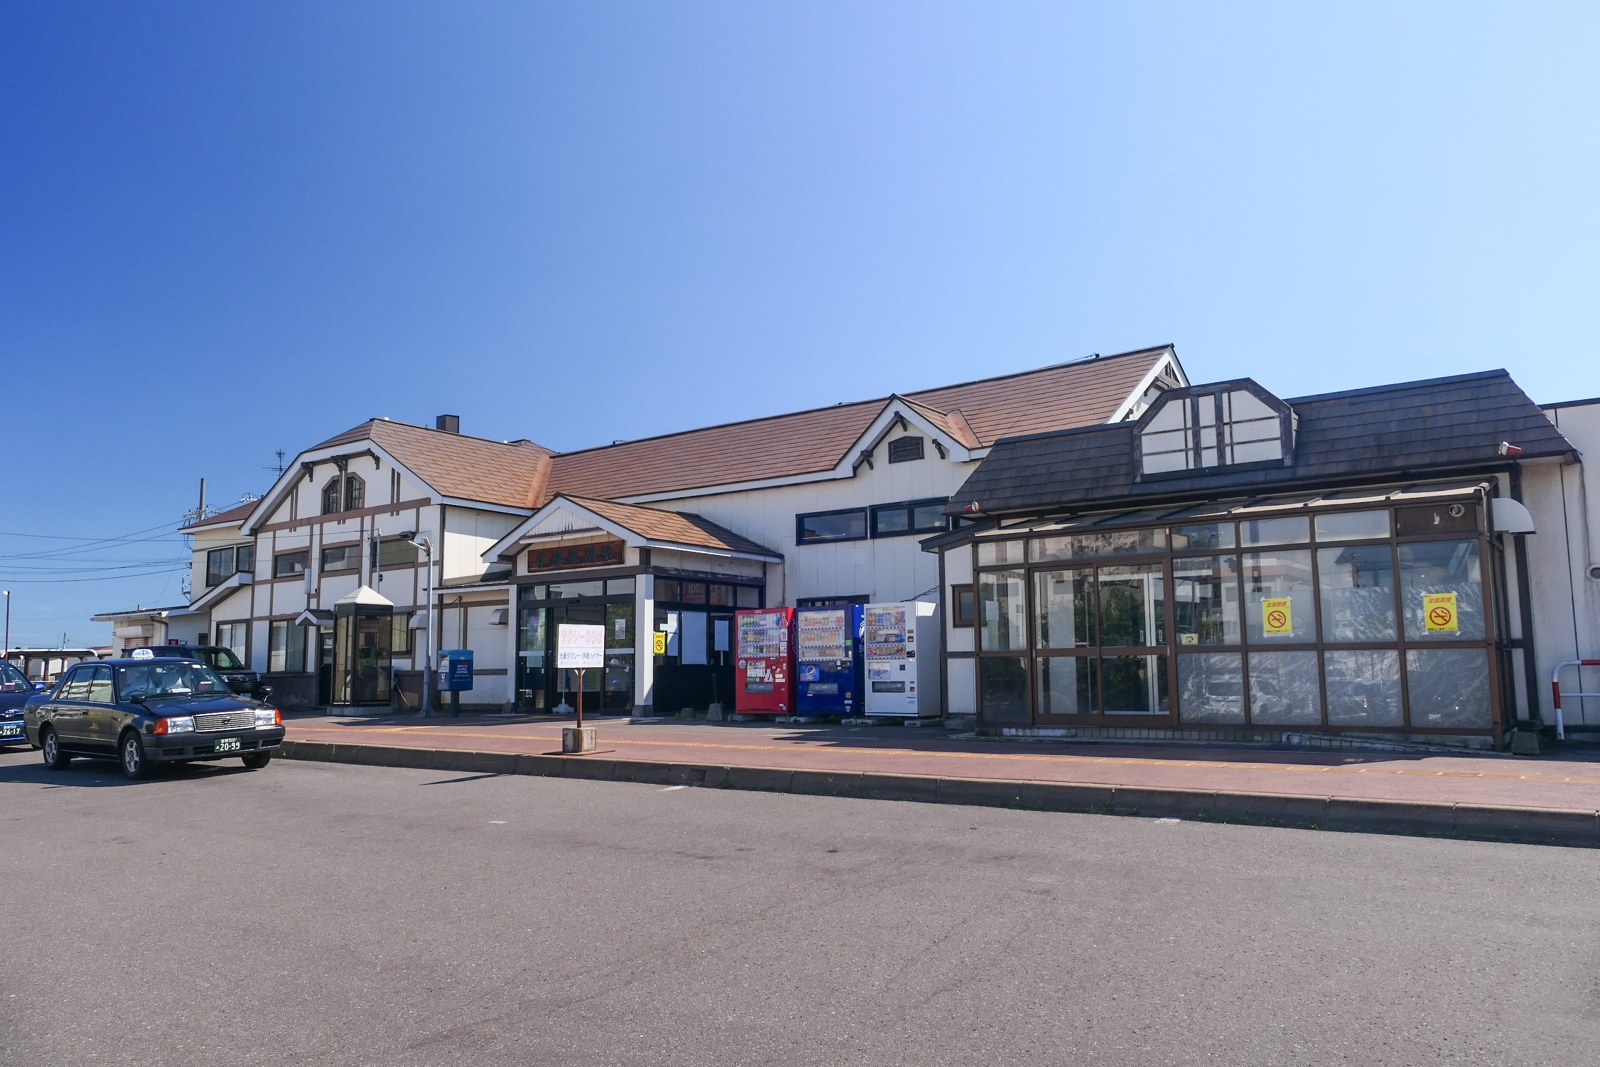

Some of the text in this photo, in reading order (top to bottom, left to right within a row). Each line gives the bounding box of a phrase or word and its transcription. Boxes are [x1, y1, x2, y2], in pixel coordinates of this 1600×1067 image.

[561, 629, 603, 645] タクシーのりば
[220, 742, 240, 751] 20-99
